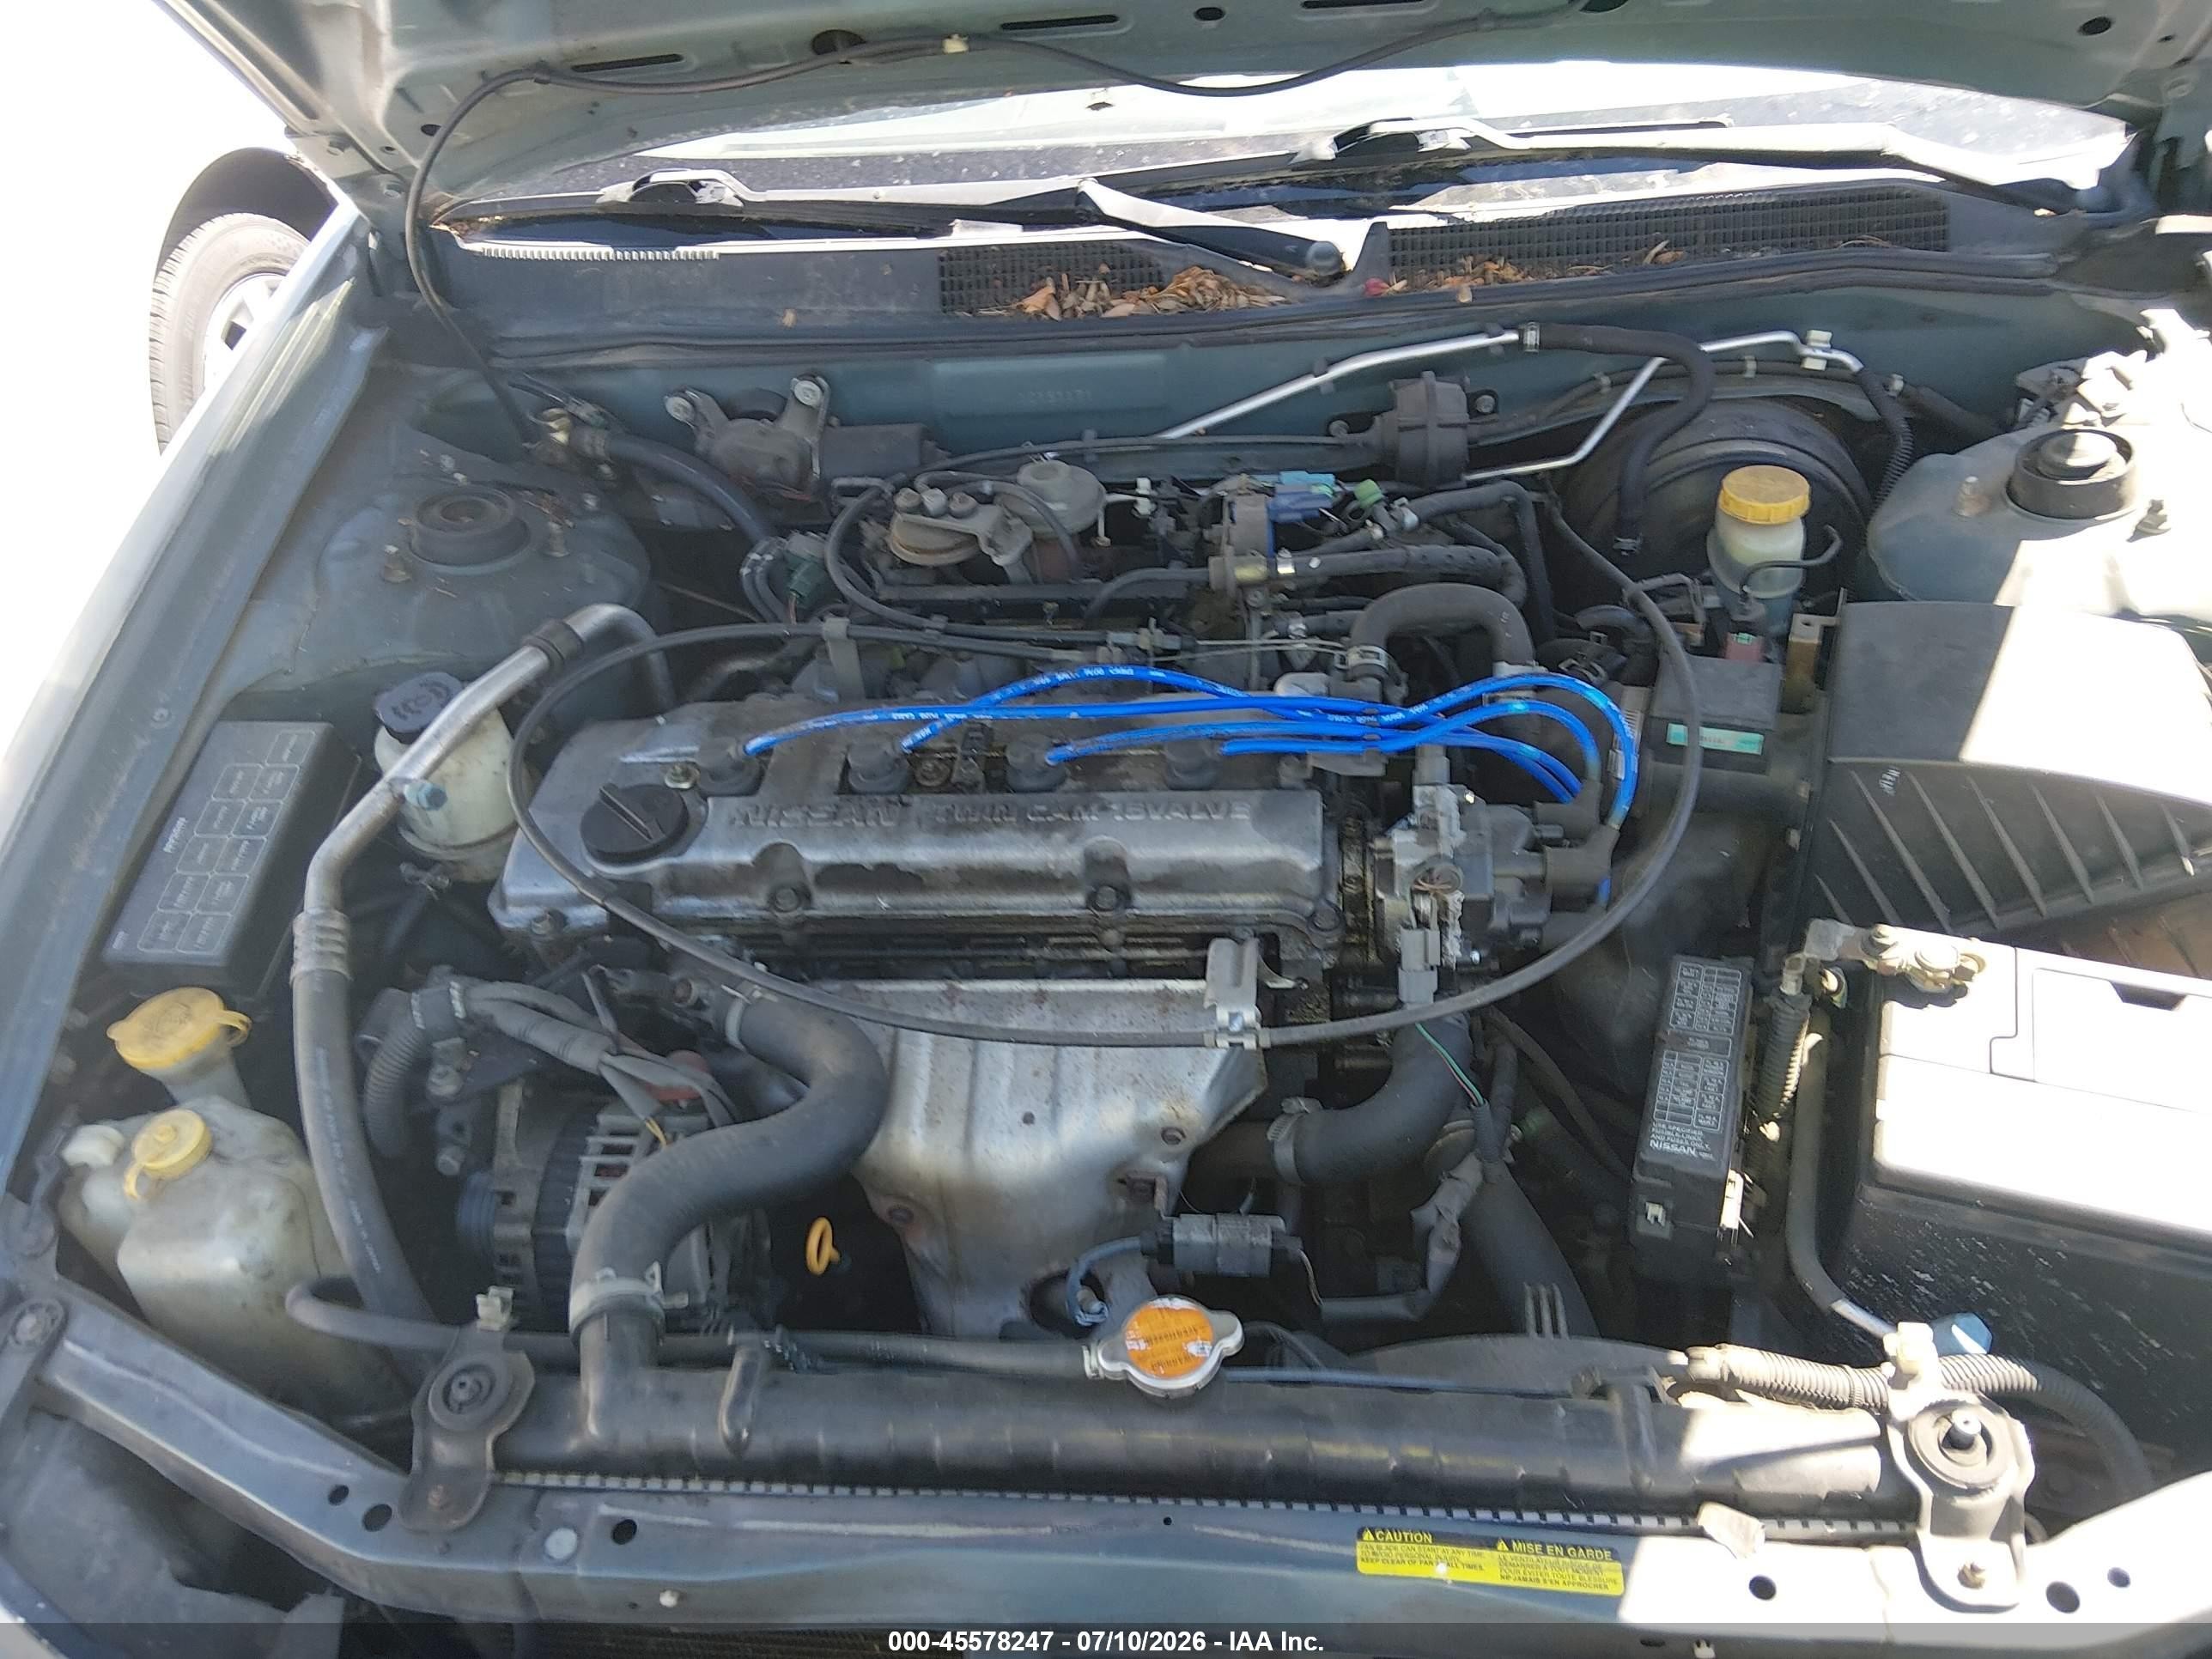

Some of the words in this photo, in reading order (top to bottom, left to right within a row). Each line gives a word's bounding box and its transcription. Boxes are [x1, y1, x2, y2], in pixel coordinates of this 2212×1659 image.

[1027, 803, 1100, 823] CAM
[1650, 1139, 1698, 1158] NISSAN
[1375, 1530, 1432, 1543] CAUTION
[1511, 1540, 1543, 1554] MISE
[1547, 1544, 1565, 1557] EN
[1567, 1547, 1613, 1560] GARDE
